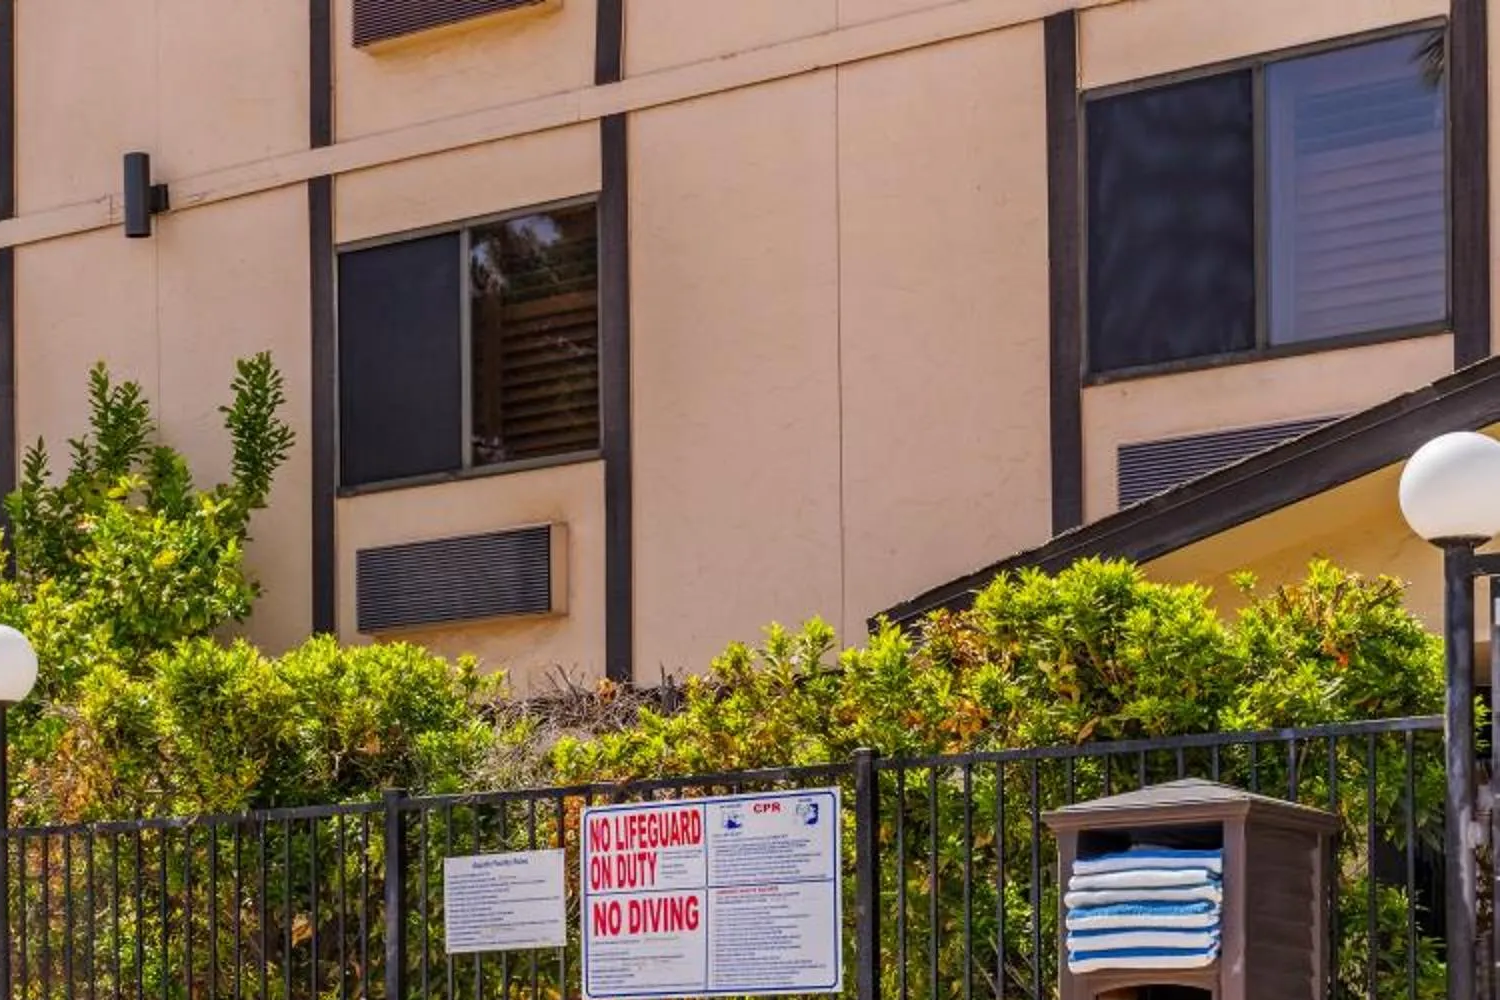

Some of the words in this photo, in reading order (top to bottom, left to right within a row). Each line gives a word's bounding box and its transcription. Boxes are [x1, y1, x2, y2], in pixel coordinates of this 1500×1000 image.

[752, 801, 781, 814] CPR
[589, 817, 611, 853] NO
[615, 809, 702, 851] LIFEGUARD
[590, 854, 612, 891] ON
[616, 850, 657, 889] DUTY
[592, 900, 622, 937] NO
[628, 895, 700, 936] DIVING
